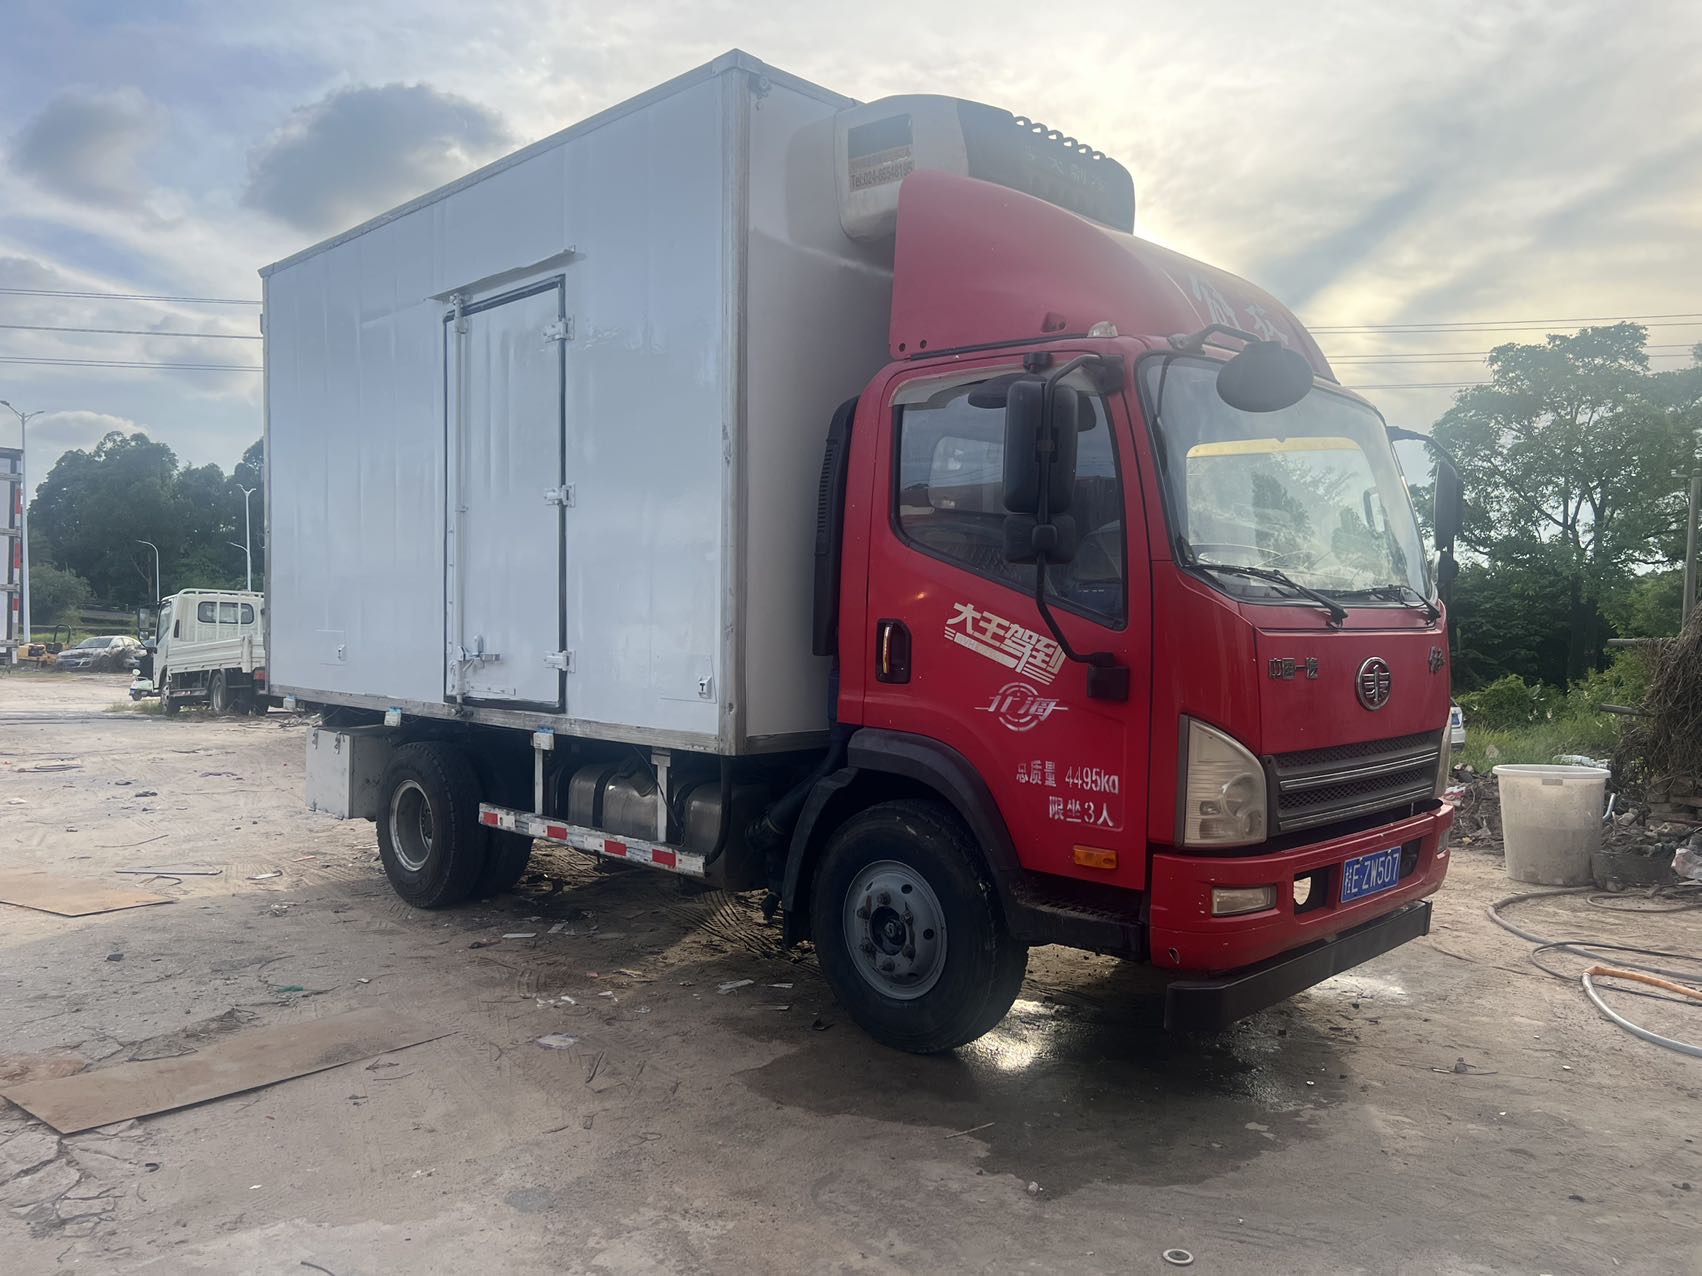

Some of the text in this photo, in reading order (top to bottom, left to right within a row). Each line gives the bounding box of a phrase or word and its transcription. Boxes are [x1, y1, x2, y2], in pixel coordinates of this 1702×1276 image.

[946, 602, 1066, 674] 大王驾到
[1269, 657, 1319, 680] 中国一汽
[1016, 760, 1057, 787] 总质量
[1049, 796, 1114, 827] 限坐3人
